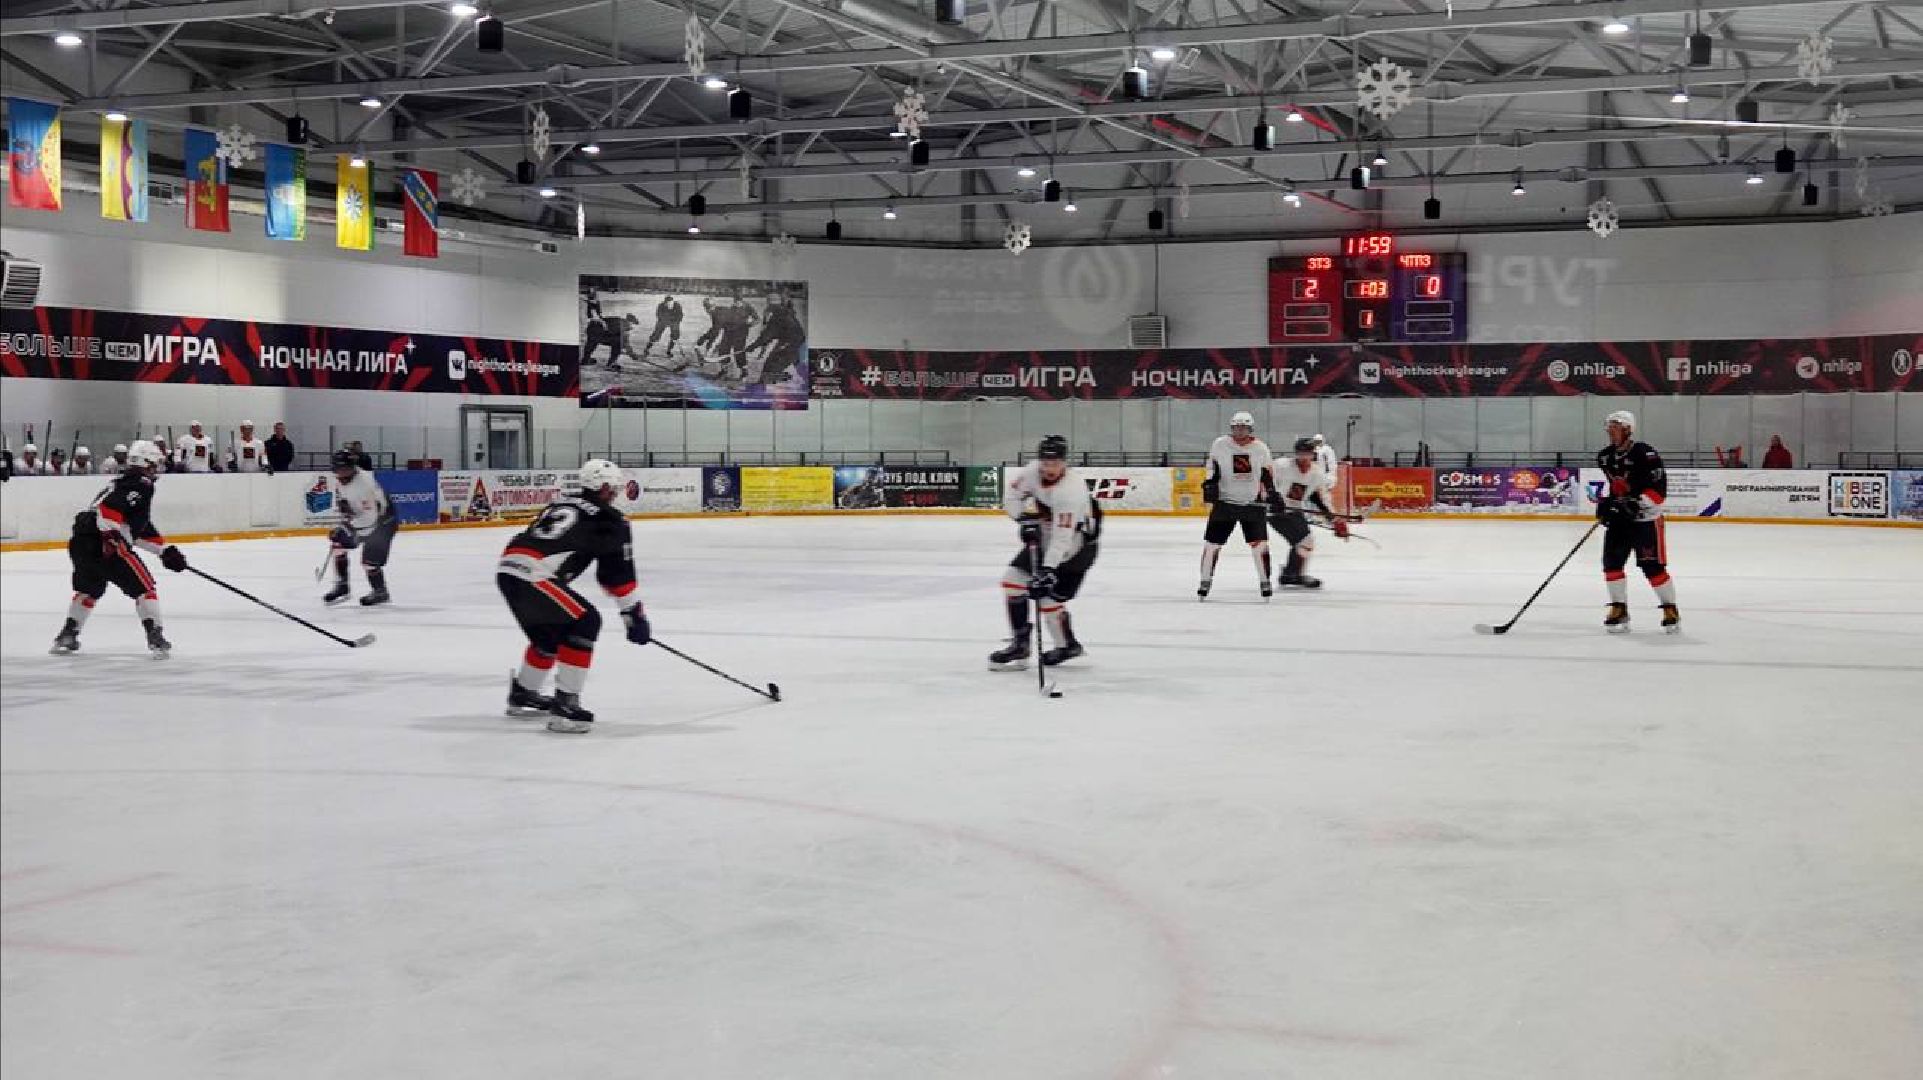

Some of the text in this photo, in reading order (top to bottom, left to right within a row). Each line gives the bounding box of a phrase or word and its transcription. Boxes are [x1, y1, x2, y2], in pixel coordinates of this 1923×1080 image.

[1347, 236, 1393, 254] 11:59
[1304, 279, 1318, 298] 2
[1427, 276, 1440, 295] 0
[143, 333, 221, 366] ИГРА
[259, 345, 408, 375] НОЧНАЯ ЛИГА
[1695, 360, 1753, 378] nhliga
[1822, 359, 1862, 374] nhliga
[1019, 365, 1097, 388] ИГРА
[1131, 367, 1308, 388] НОЧНАЯ ЛИГА
[1383, 364, 1508, 378] nighthockeyleague
[1573, 362, 1626, 379] nhliga
[904, 472, 927, 484] ПОД
